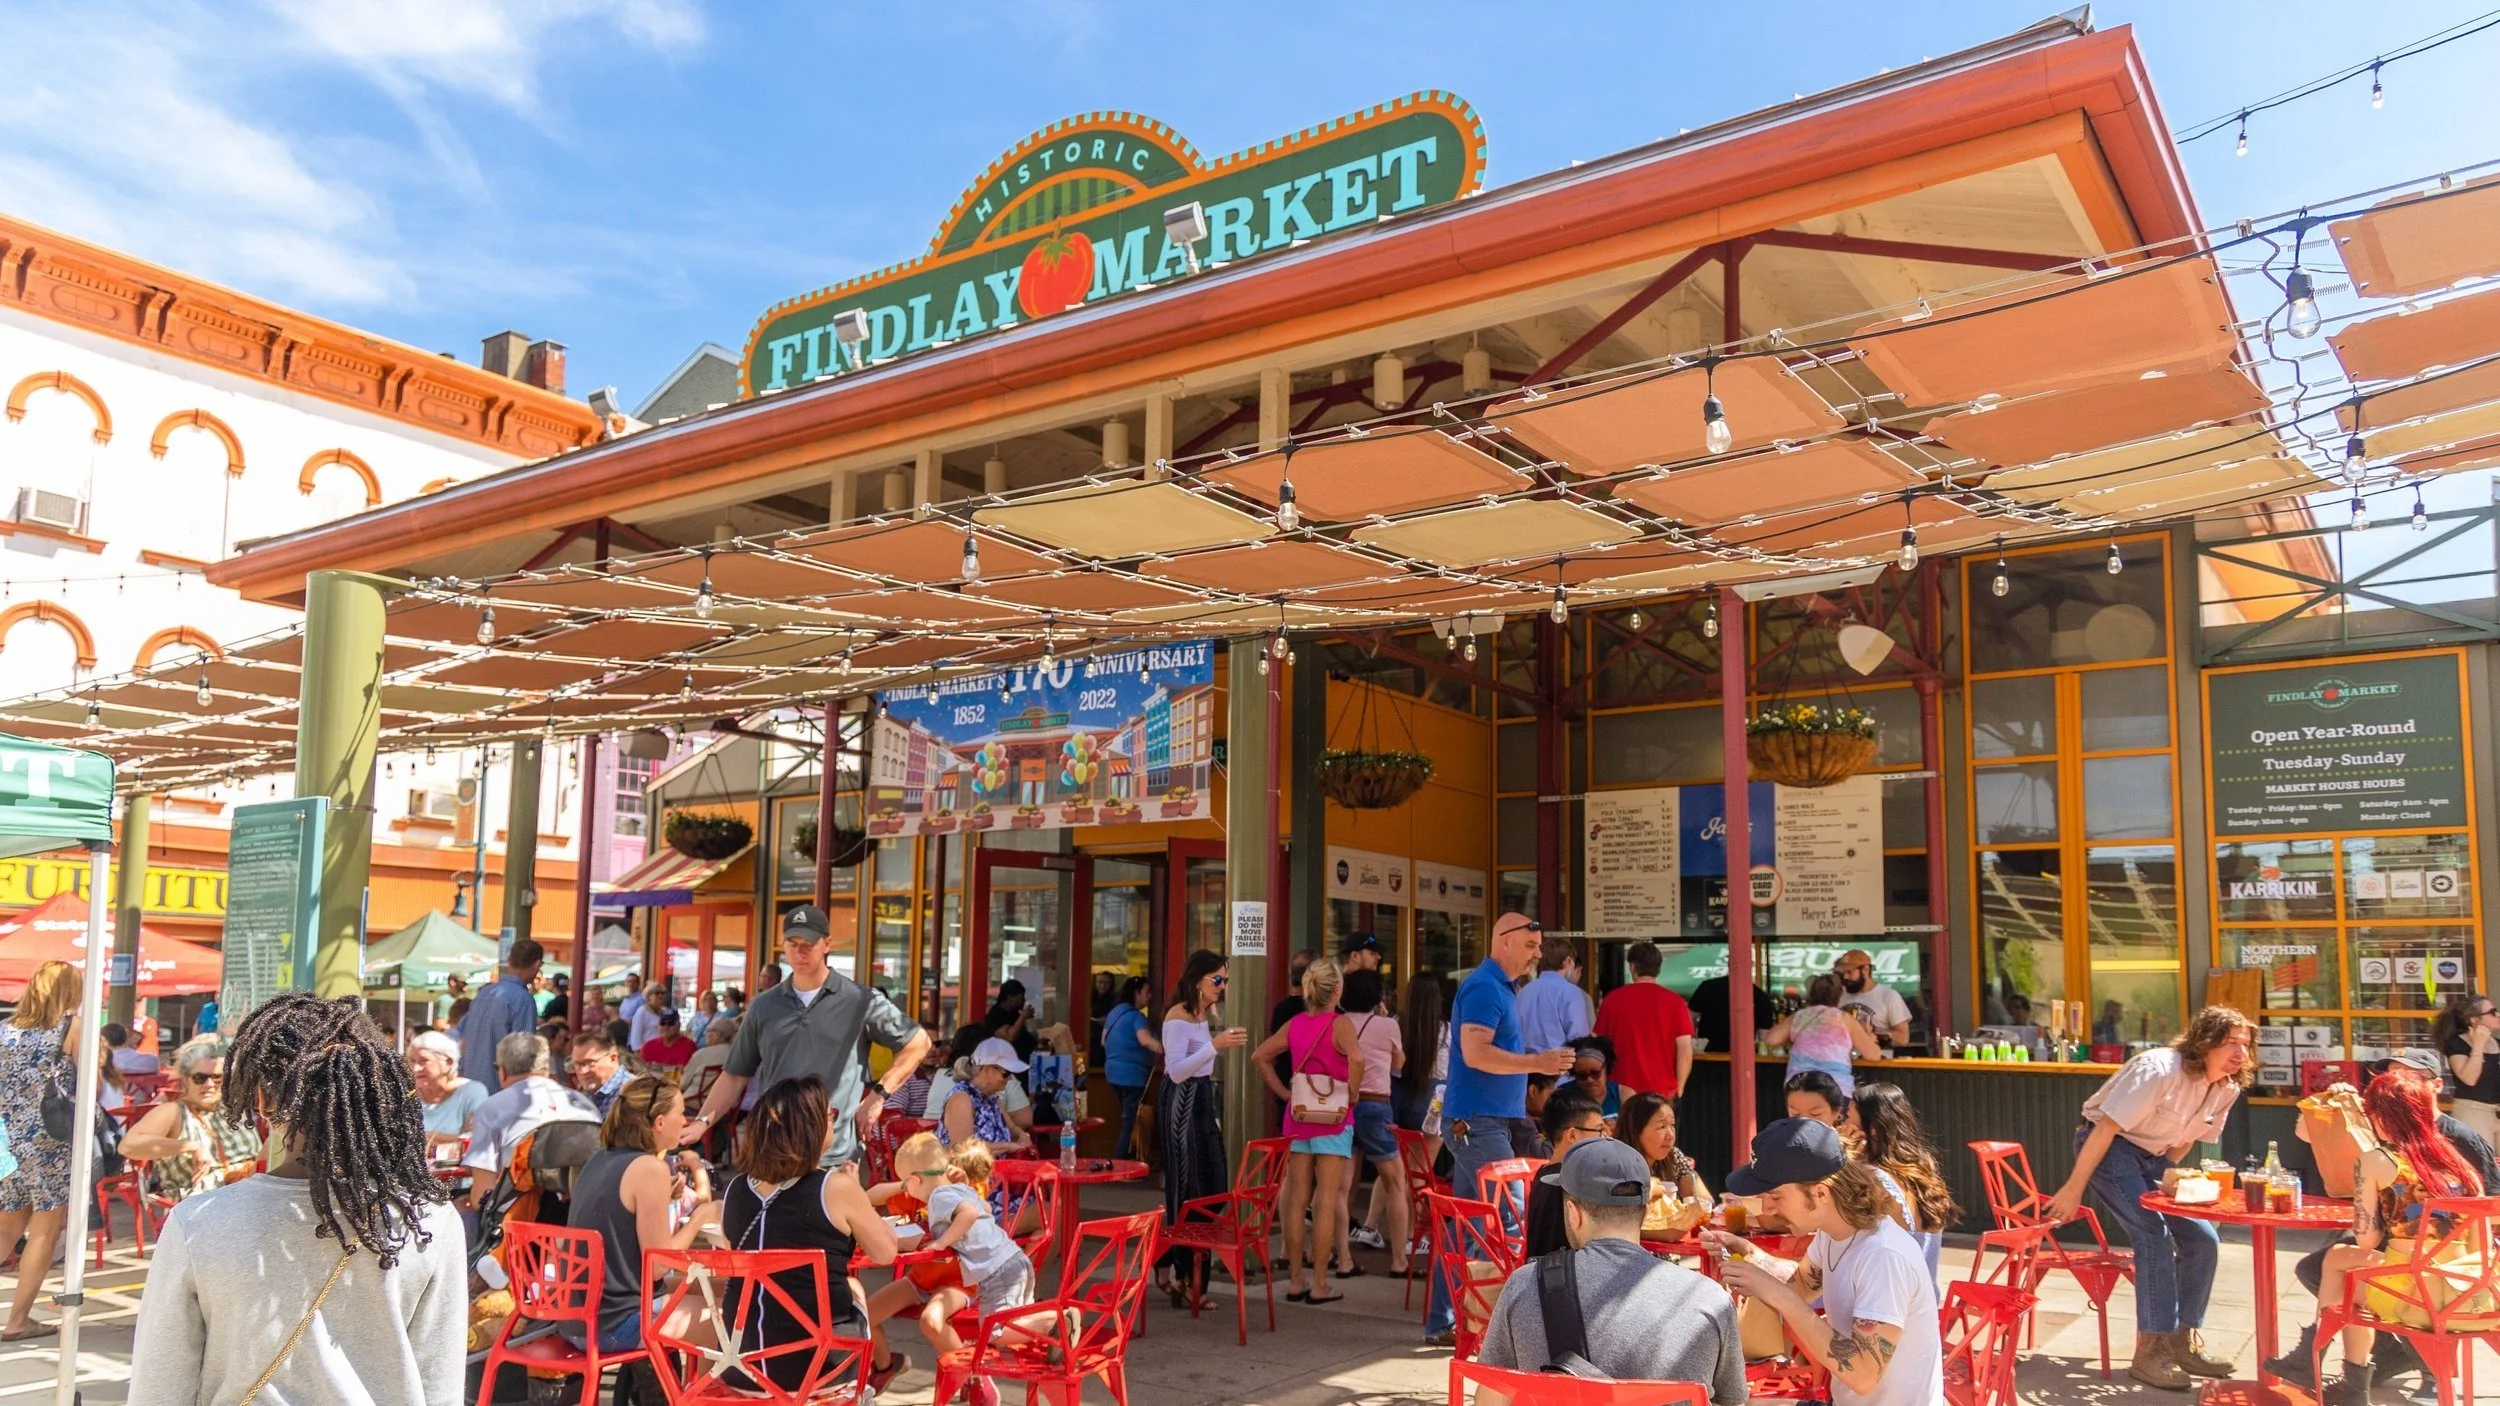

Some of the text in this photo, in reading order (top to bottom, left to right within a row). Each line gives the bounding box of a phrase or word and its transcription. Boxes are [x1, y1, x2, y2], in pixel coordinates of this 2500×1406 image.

[975, 138, 1149, 222] HISTORIC
[1079, 687, 1116, 712] 2022
[2267, 684, 2399, 702] FINDLAY MARKET
[953, 704, 985, 726] 1852
[2251, 719, 2417, 746] Open Year-Round
[2263, 751, 2406, 770] Tuesday-Sunday
[2265, 778, 2406, 794] MARKET HOUSE HOURS
[2227, 805, 2263, 814] Tuesday
[2359, 800, 2402, 809] Saturday:
[2227, 818, 2261, 827] Sunday:
[2360, 811, 2431, 821] Monday: Closed
[1750, 873, 1775, 881] CREDIT
[2229, 881, 2318, 899] KARRIKIN
[2241, 945, 2317, 955] NORTHERN
[2241, 955, 2274, 965] ROW
